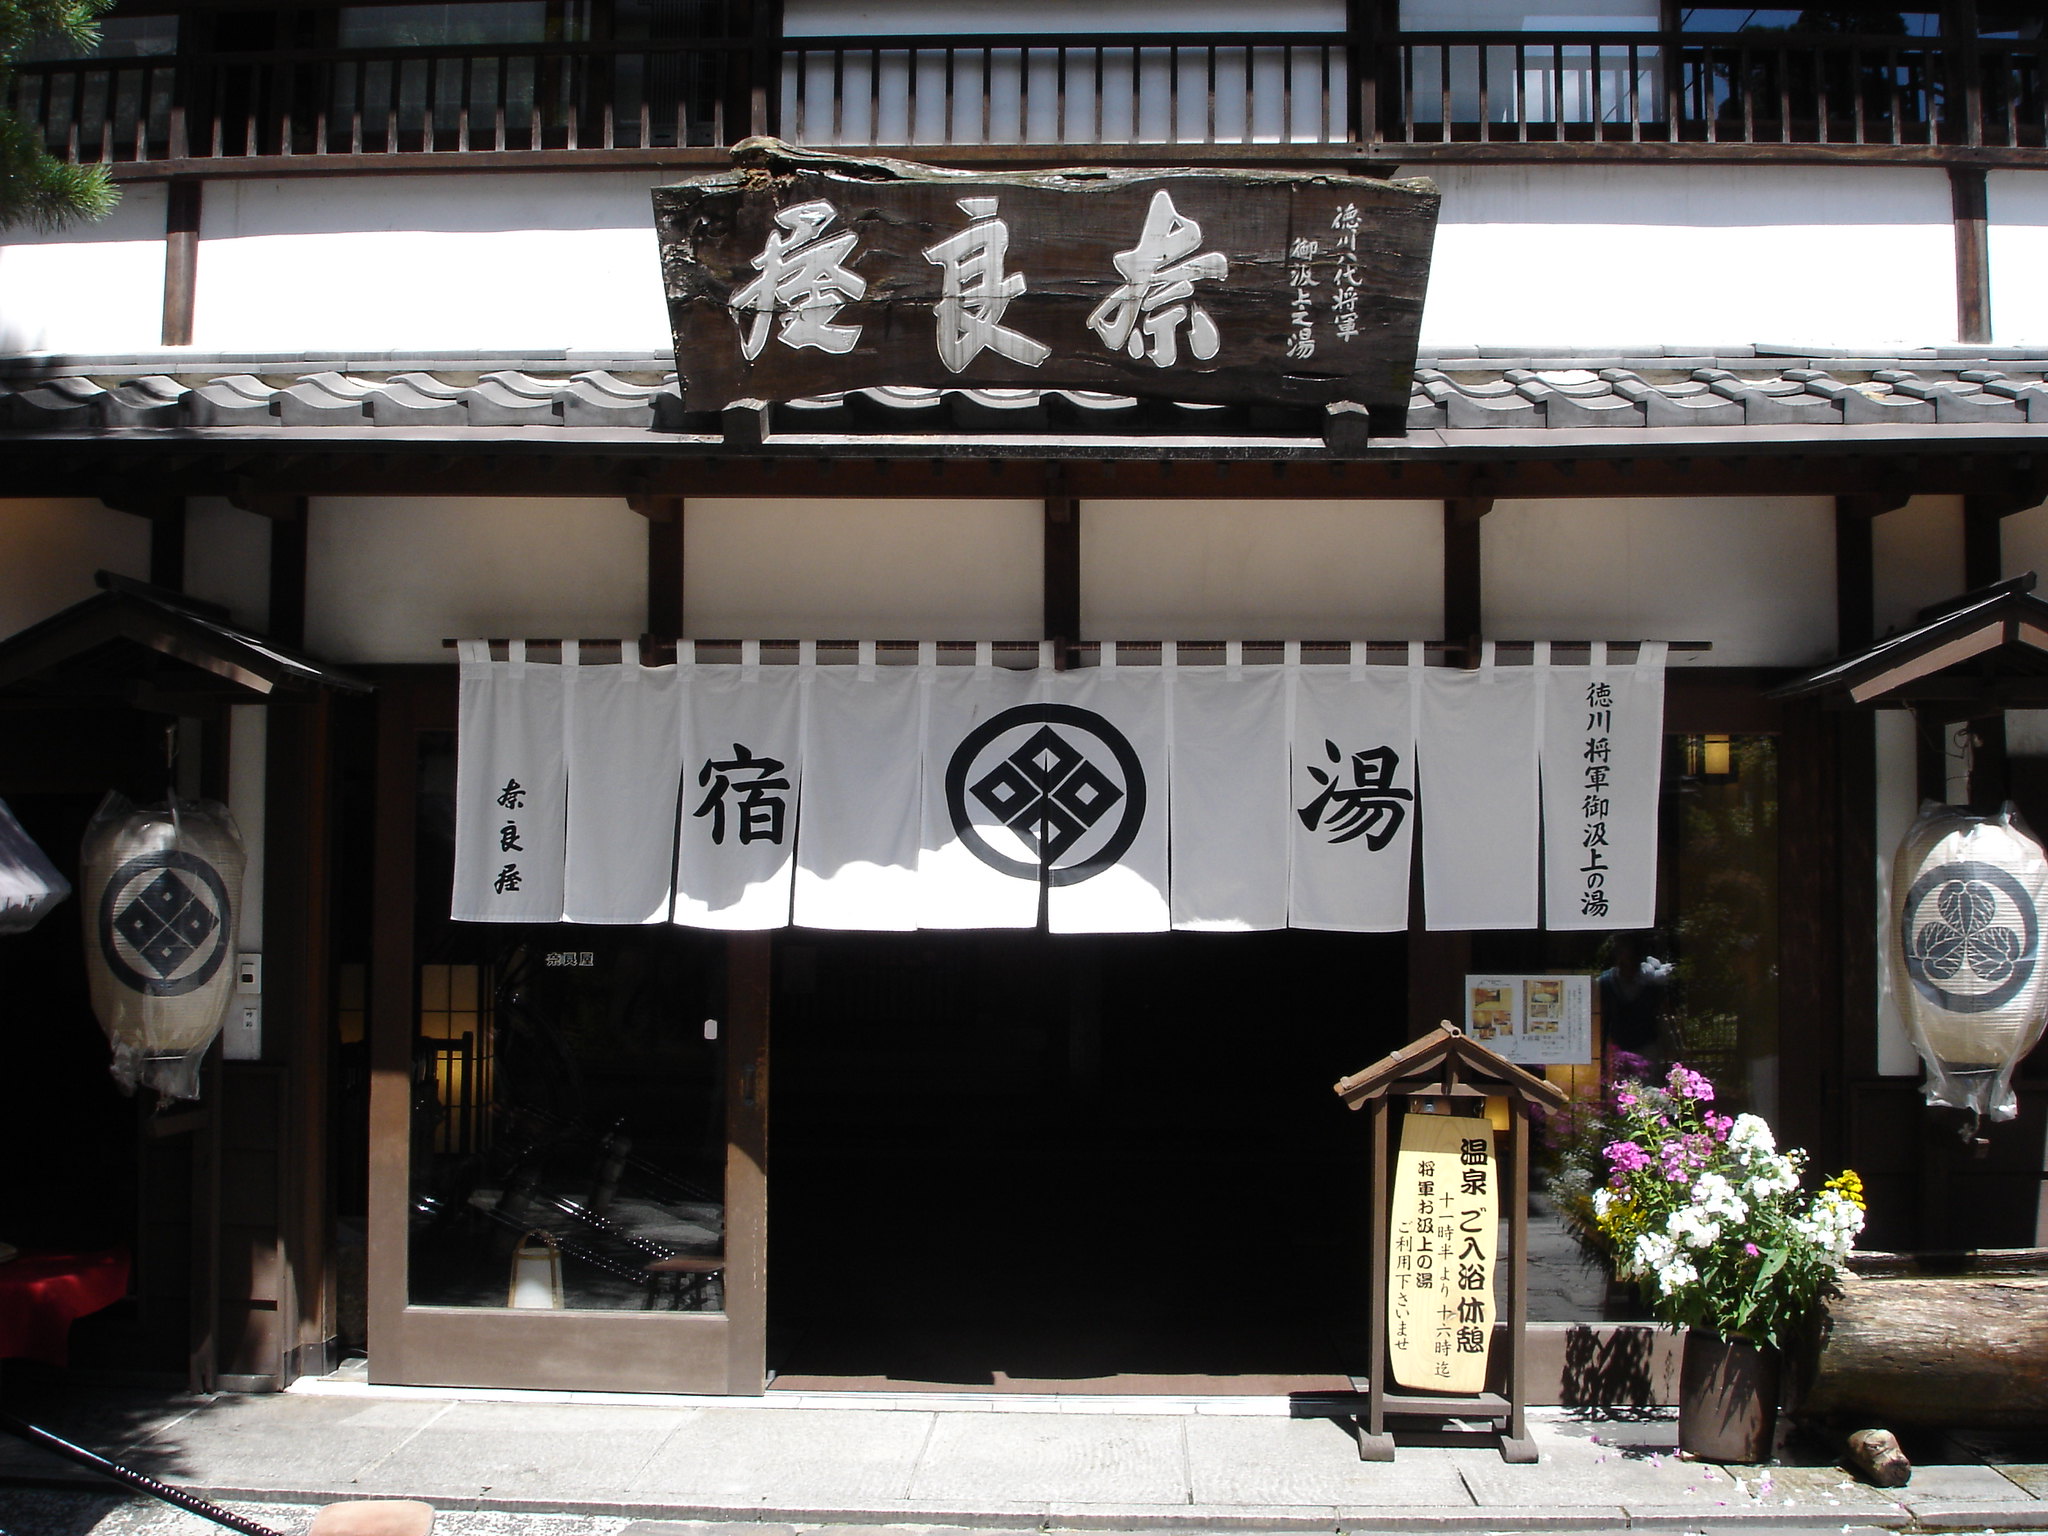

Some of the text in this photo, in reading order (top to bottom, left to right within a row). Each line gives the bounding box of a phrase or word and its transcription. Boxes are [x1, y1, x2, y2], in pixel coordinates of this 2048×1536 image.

[494, 778, 526, 894] 奈良屋
[694, 743, 790, 845] 宿
[1297, 739, 1413, 852] 湯
[1580, 682, 1613, 917] 徳川将軍御汲上の湯
[1394, 1221, 1413, 1351] ご利用下さいませ
